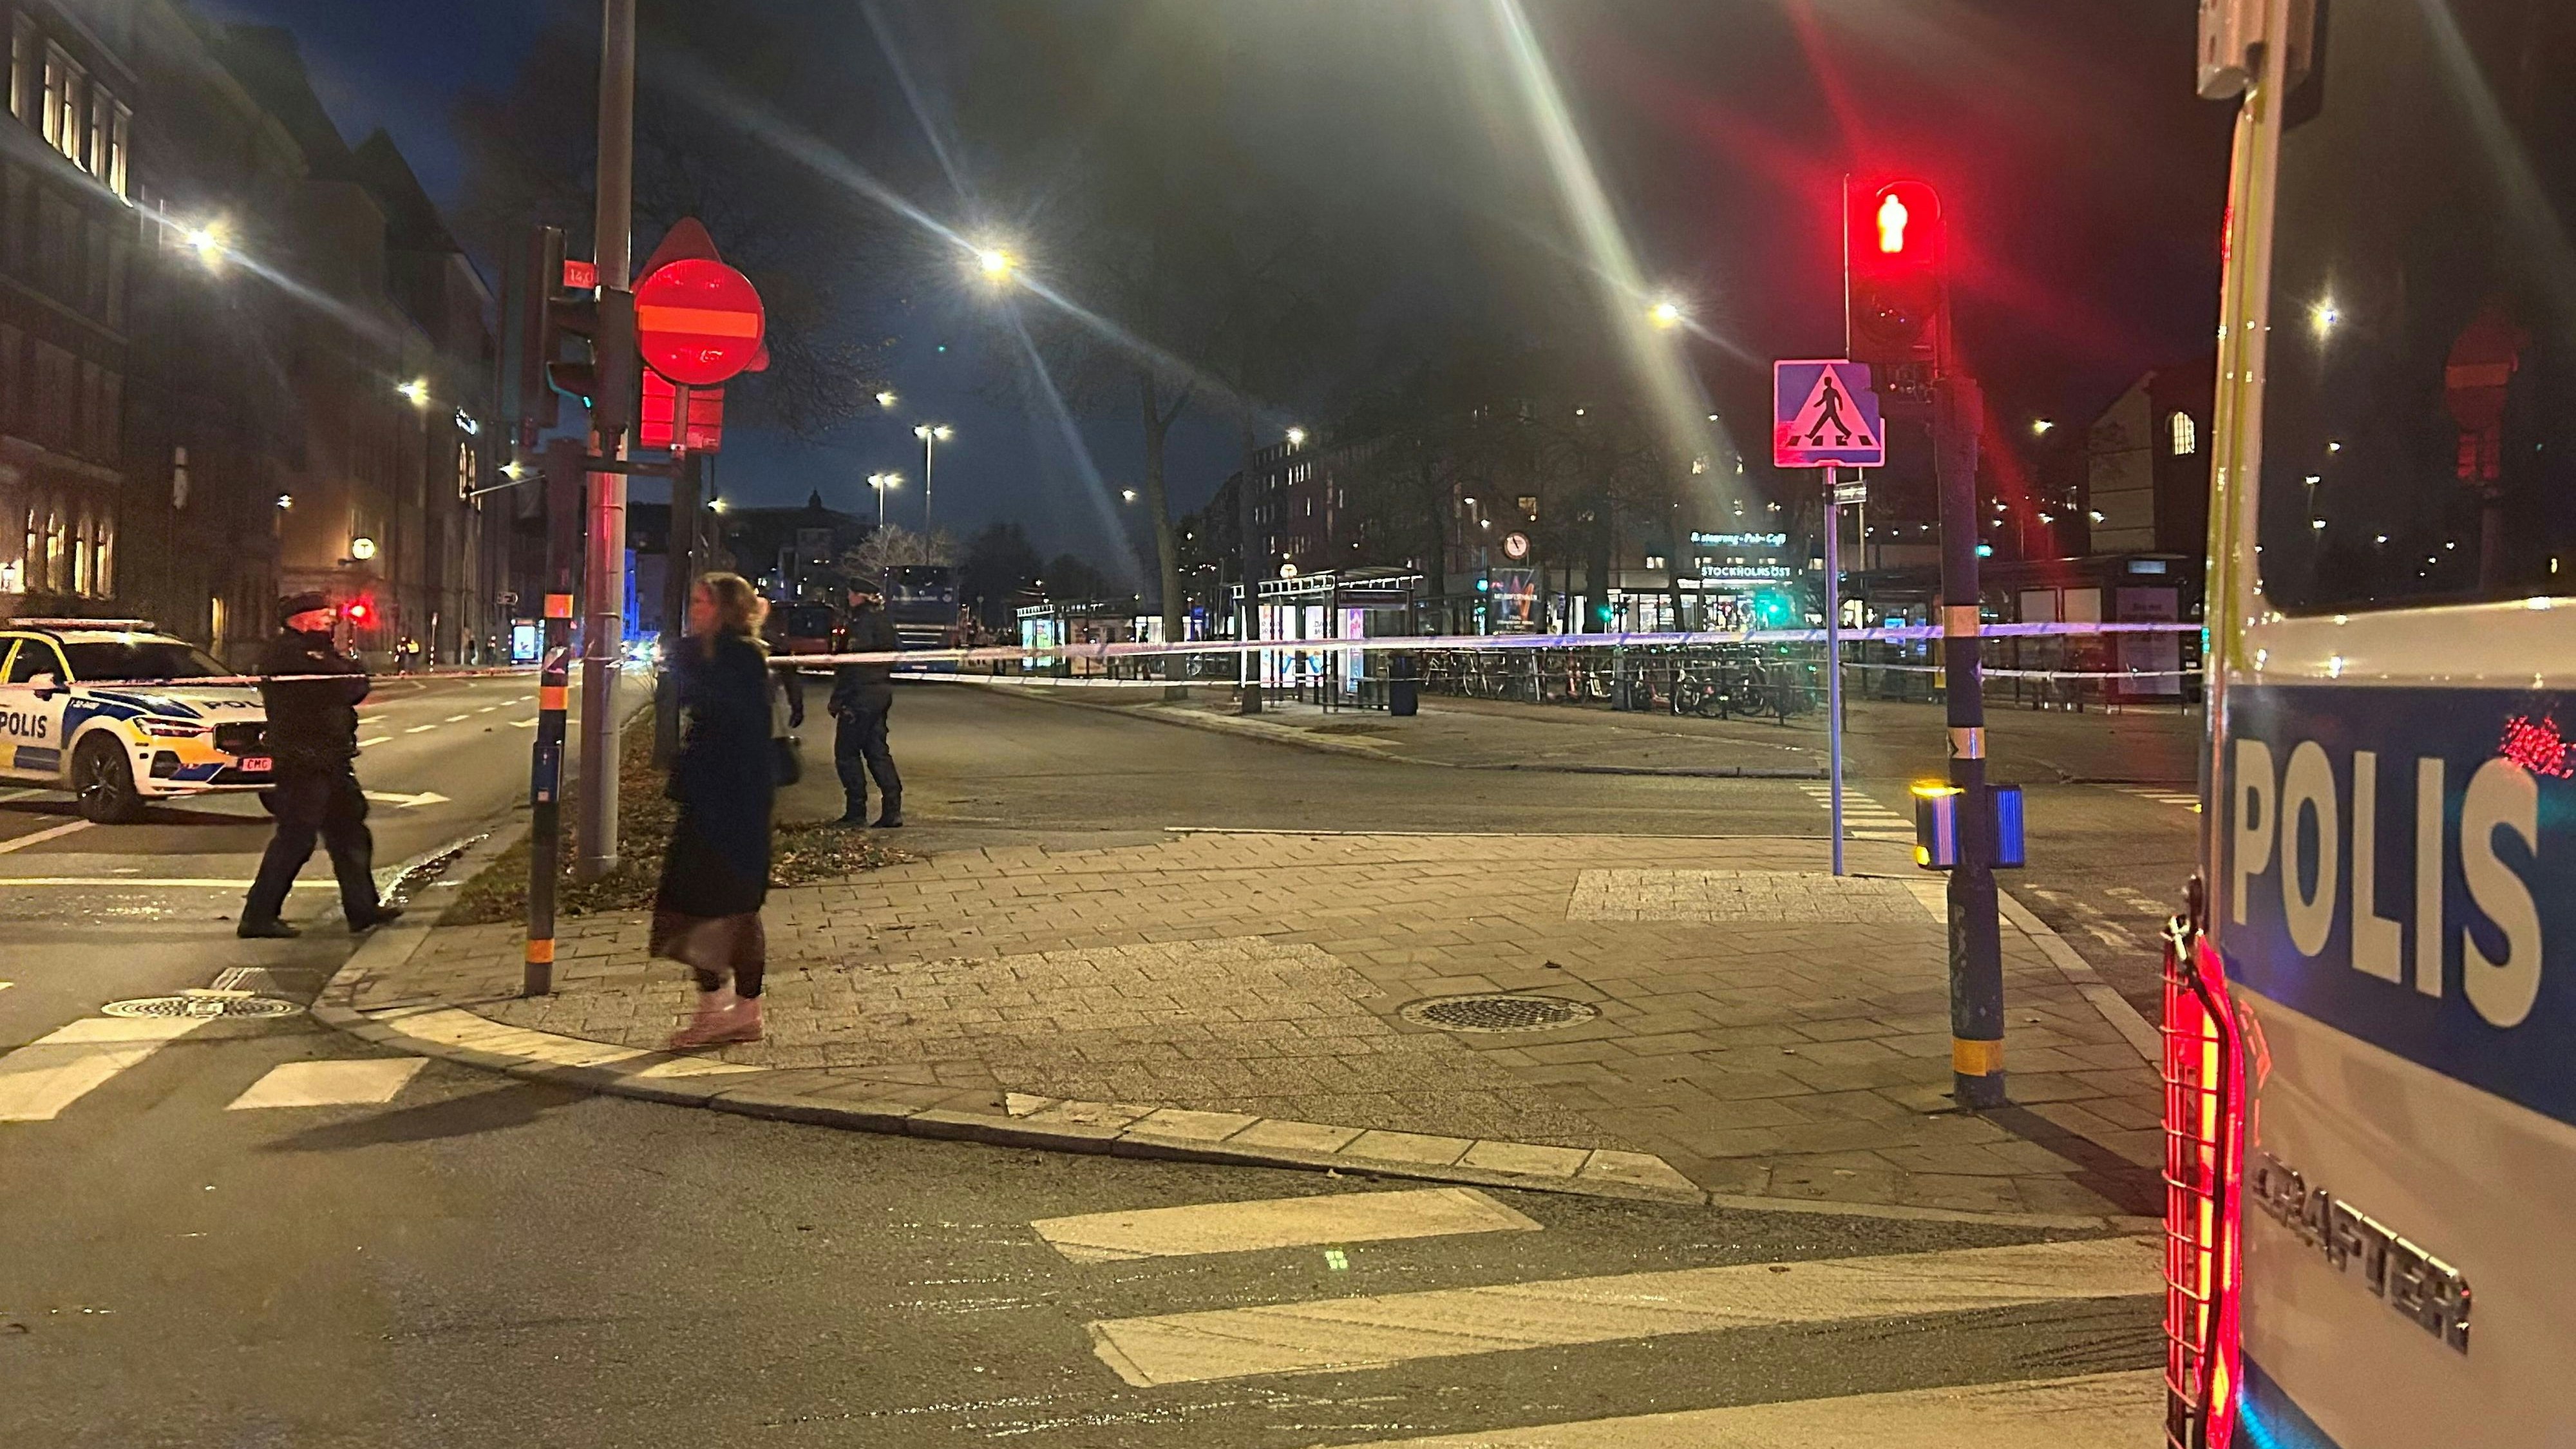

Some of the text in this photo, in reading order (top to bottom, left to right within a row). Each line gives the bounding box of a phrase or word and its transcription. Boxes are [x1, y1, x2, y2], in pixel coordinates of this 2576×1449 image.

[1690, 532, 1739, 545] Rstaurang
[201, 701, 264, 710] POL
[0, 712, 47, 739] POLIS
[2233, 738, 2543, 1028] POLIS
[2251, 1151, 2472, 1357] CRAFTER
